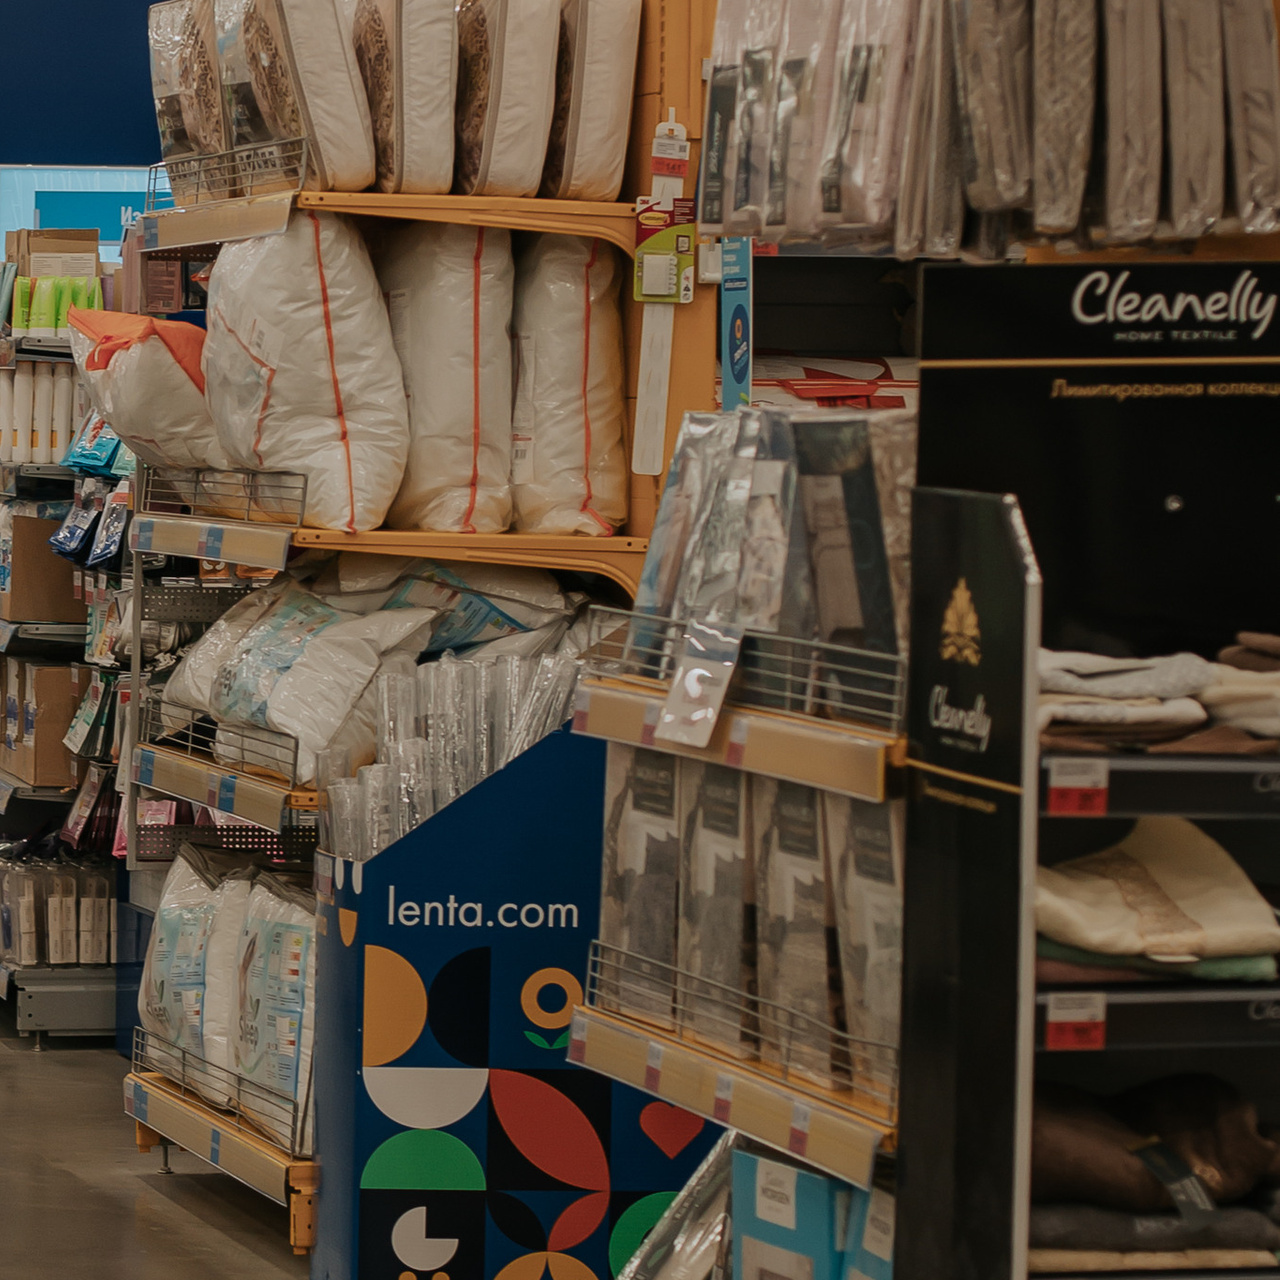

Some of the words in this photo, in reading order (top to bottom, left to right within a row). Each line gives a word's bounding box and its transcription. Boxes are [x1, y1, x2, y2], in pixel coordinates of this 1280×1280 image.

[1070, 269, 1278, 341] Cleanelly
[1170, 329, 1238, 341] TEXTILE
[1206, 382, 1280, 398] коллекц
[387, 884, 579, 929] lenta.com
